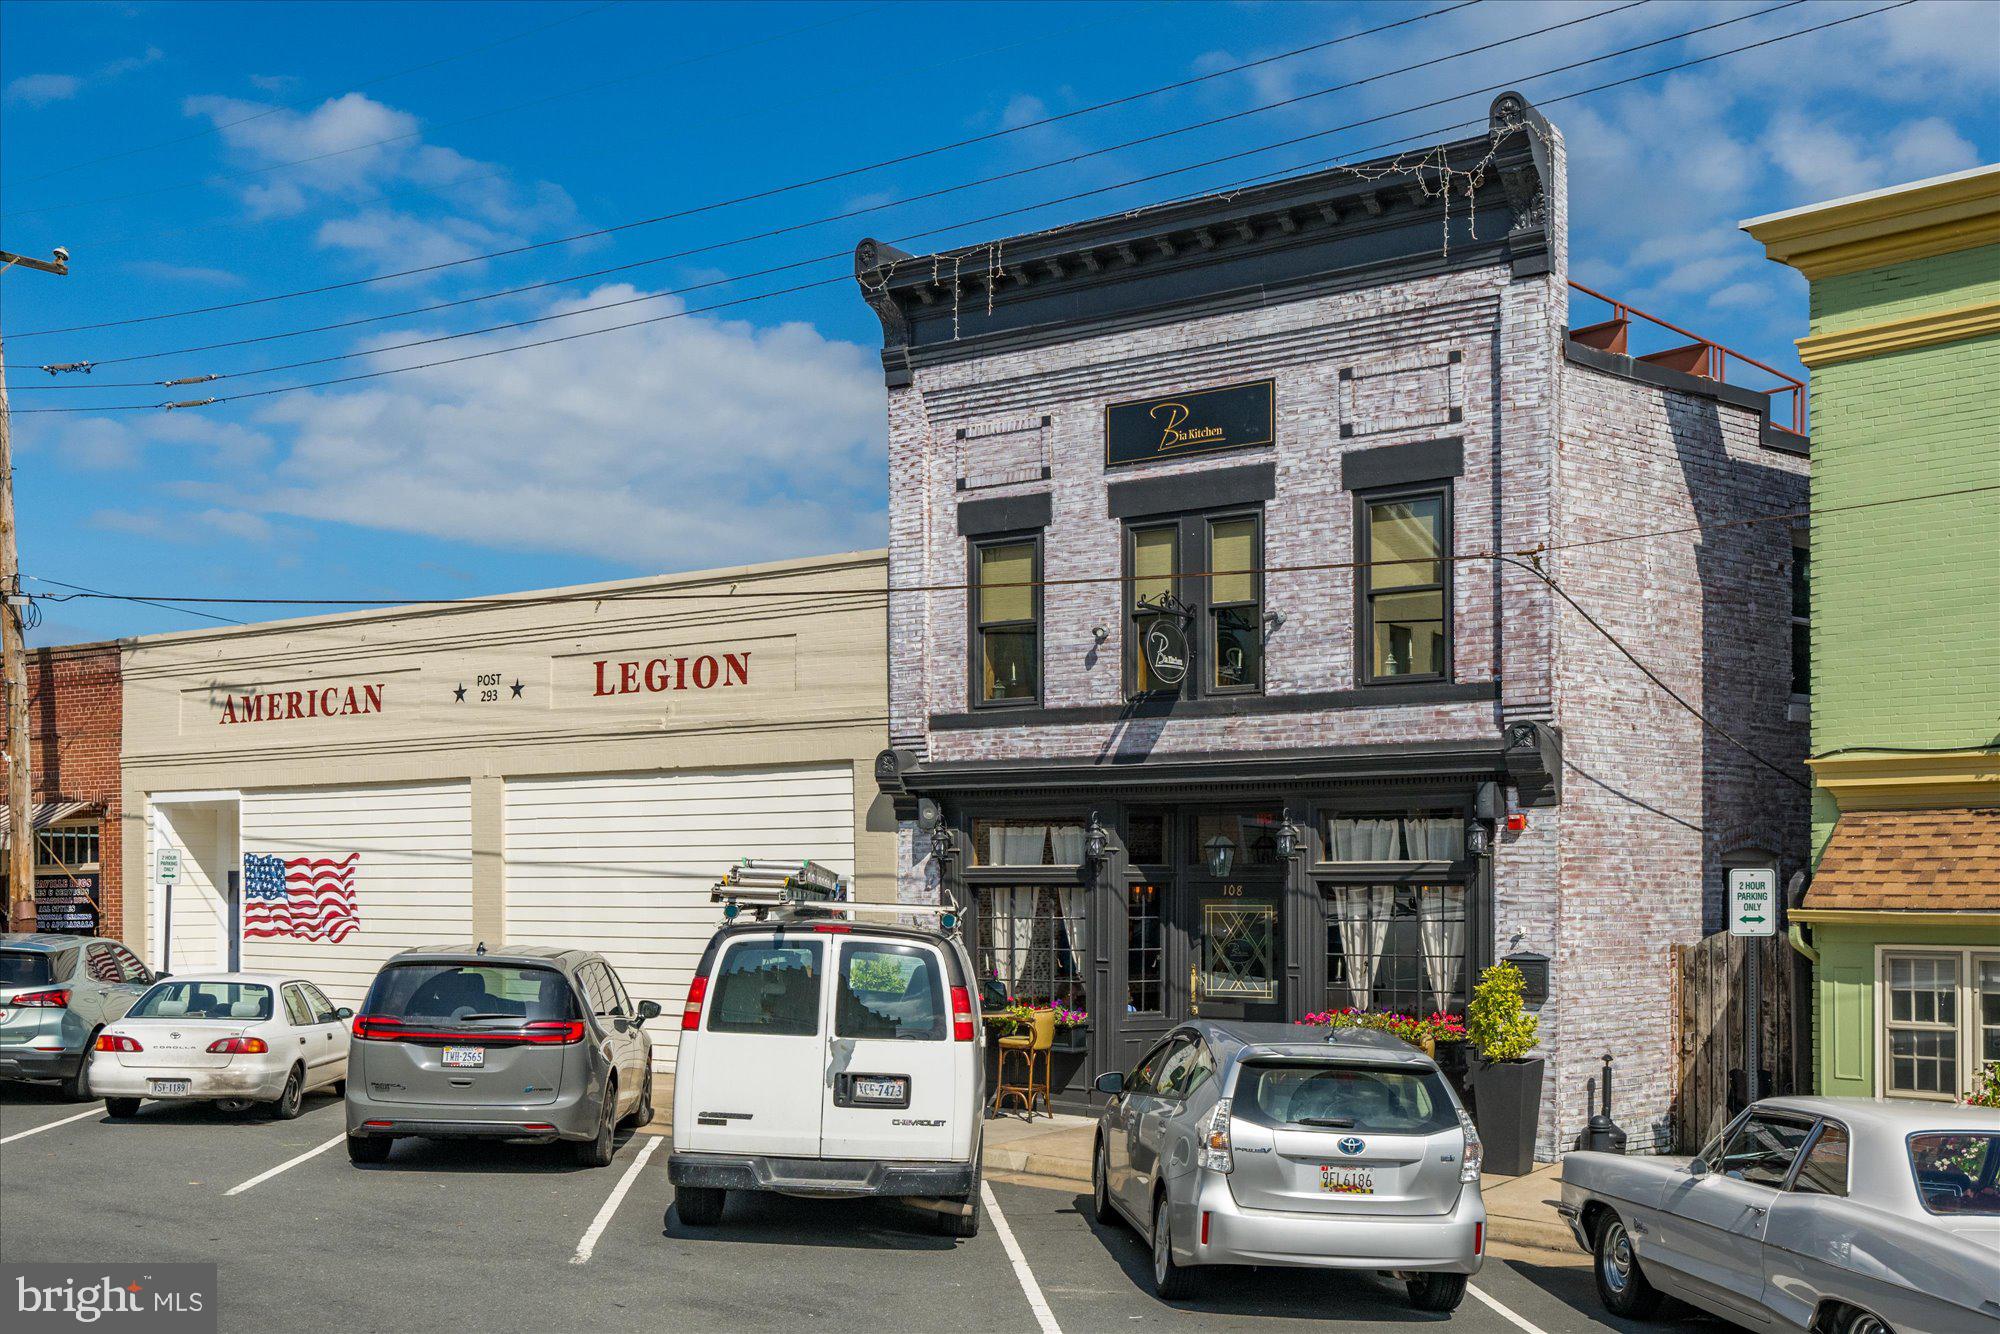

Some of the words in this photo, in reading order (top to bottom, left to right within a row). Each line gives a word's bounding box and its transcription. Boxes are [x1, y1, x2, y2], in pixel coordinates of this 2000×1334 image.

[1150, 402, 1189, 451] Bia
[1188, 427, 1223, 439] Kitchen
[476, 673, 502, 688] POST
[593, 652, 752, 697] LEGION
[480, 690, 499, 703] 293
[219, 684, 385, 725] AMERICAN
[1223, 884, 1244, 896] 108
[1739, 882, 1744, 890] 2
[1745, 882, 1766, 890] HOUR
[1737, 892, 1768, 901] PARKING
[1743, 903, 1762, 912] ONLY
[892, 1119, 947, 1128] CHEVROLET
[1322, 1171, 1372, 1188] 9FL6186
